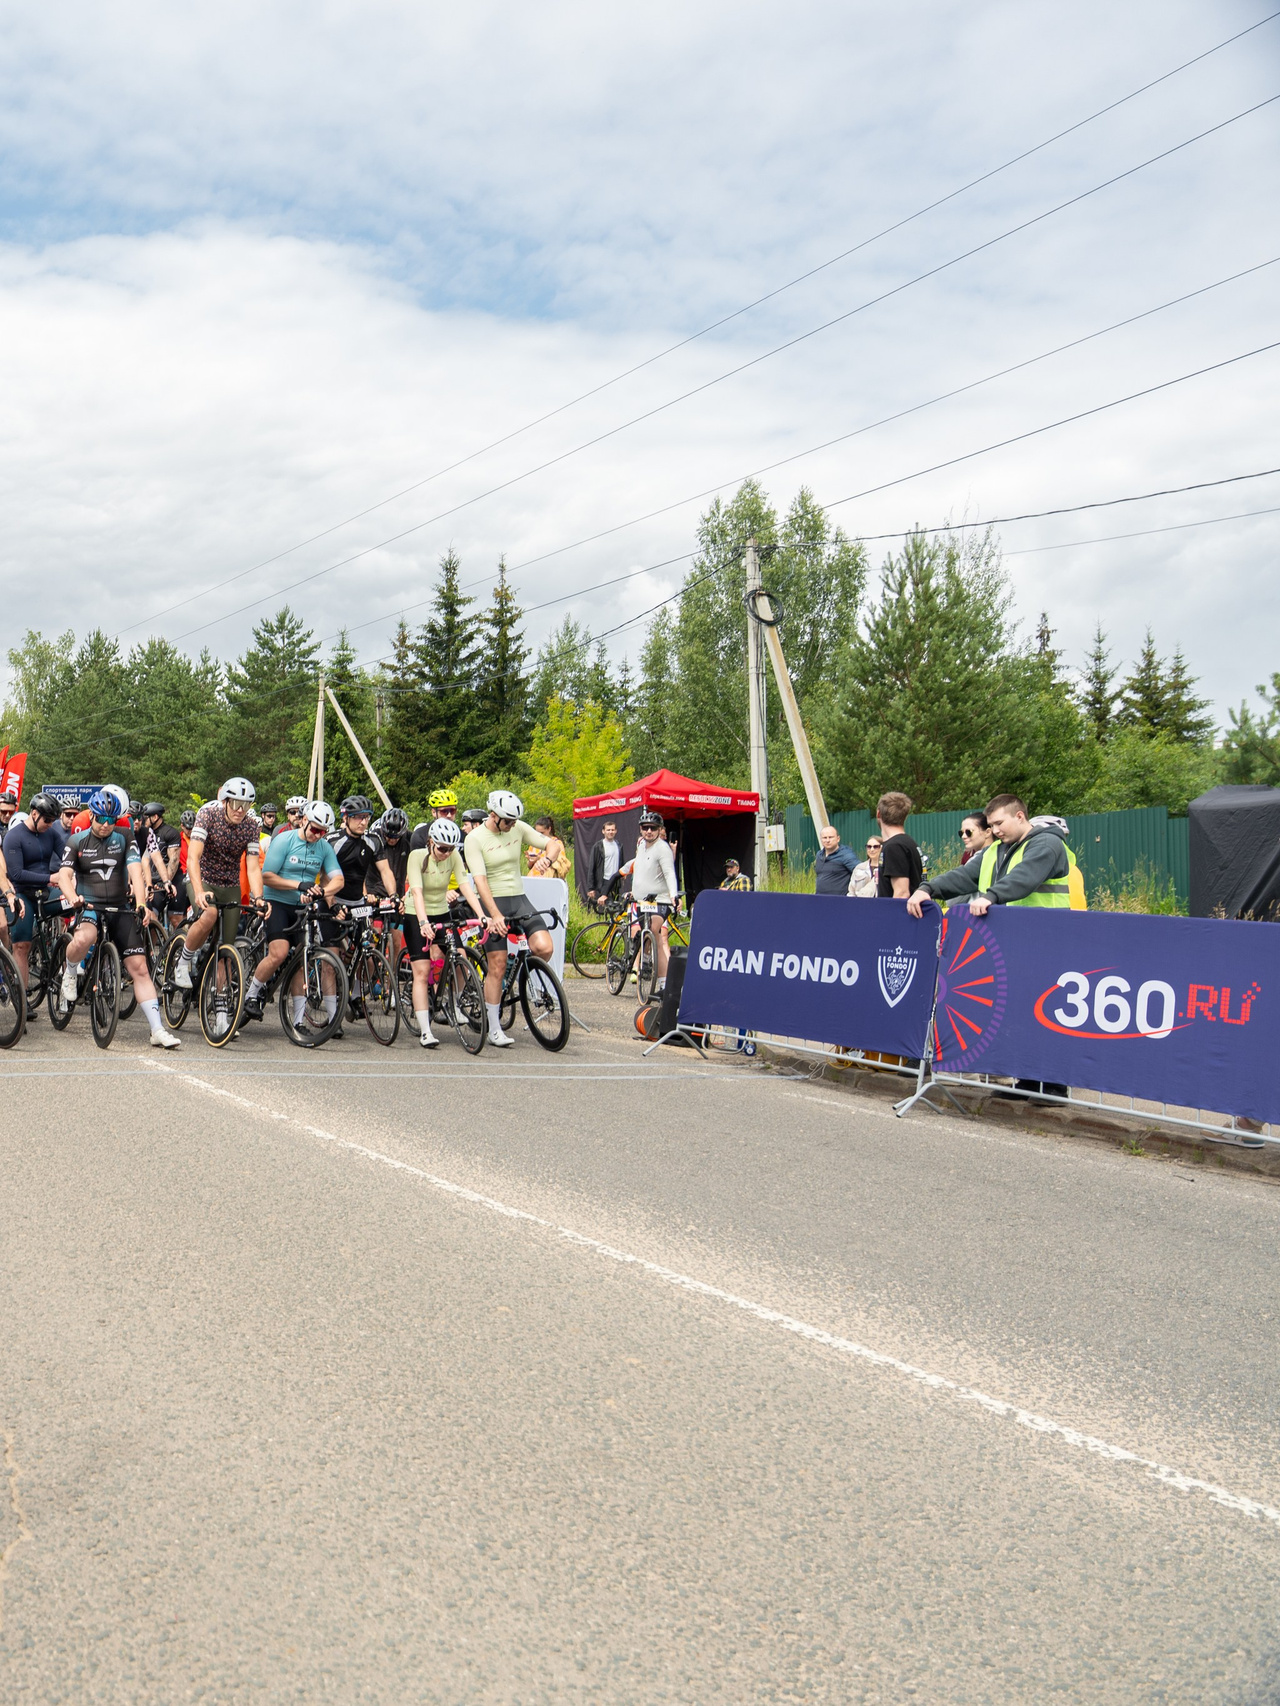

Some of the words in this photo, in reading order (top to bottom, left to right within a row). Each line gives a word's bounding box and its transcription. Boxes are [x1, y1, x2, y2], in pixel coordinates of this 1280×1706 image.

[699, 946, 765, 976] GRAN
[770, 952, 860, 986] FONDO
[886, 962, 908, 970] FONDO
[887, 955, 908, 963] GRAN
[1054, 971, 1261, 1039] 360.RU
